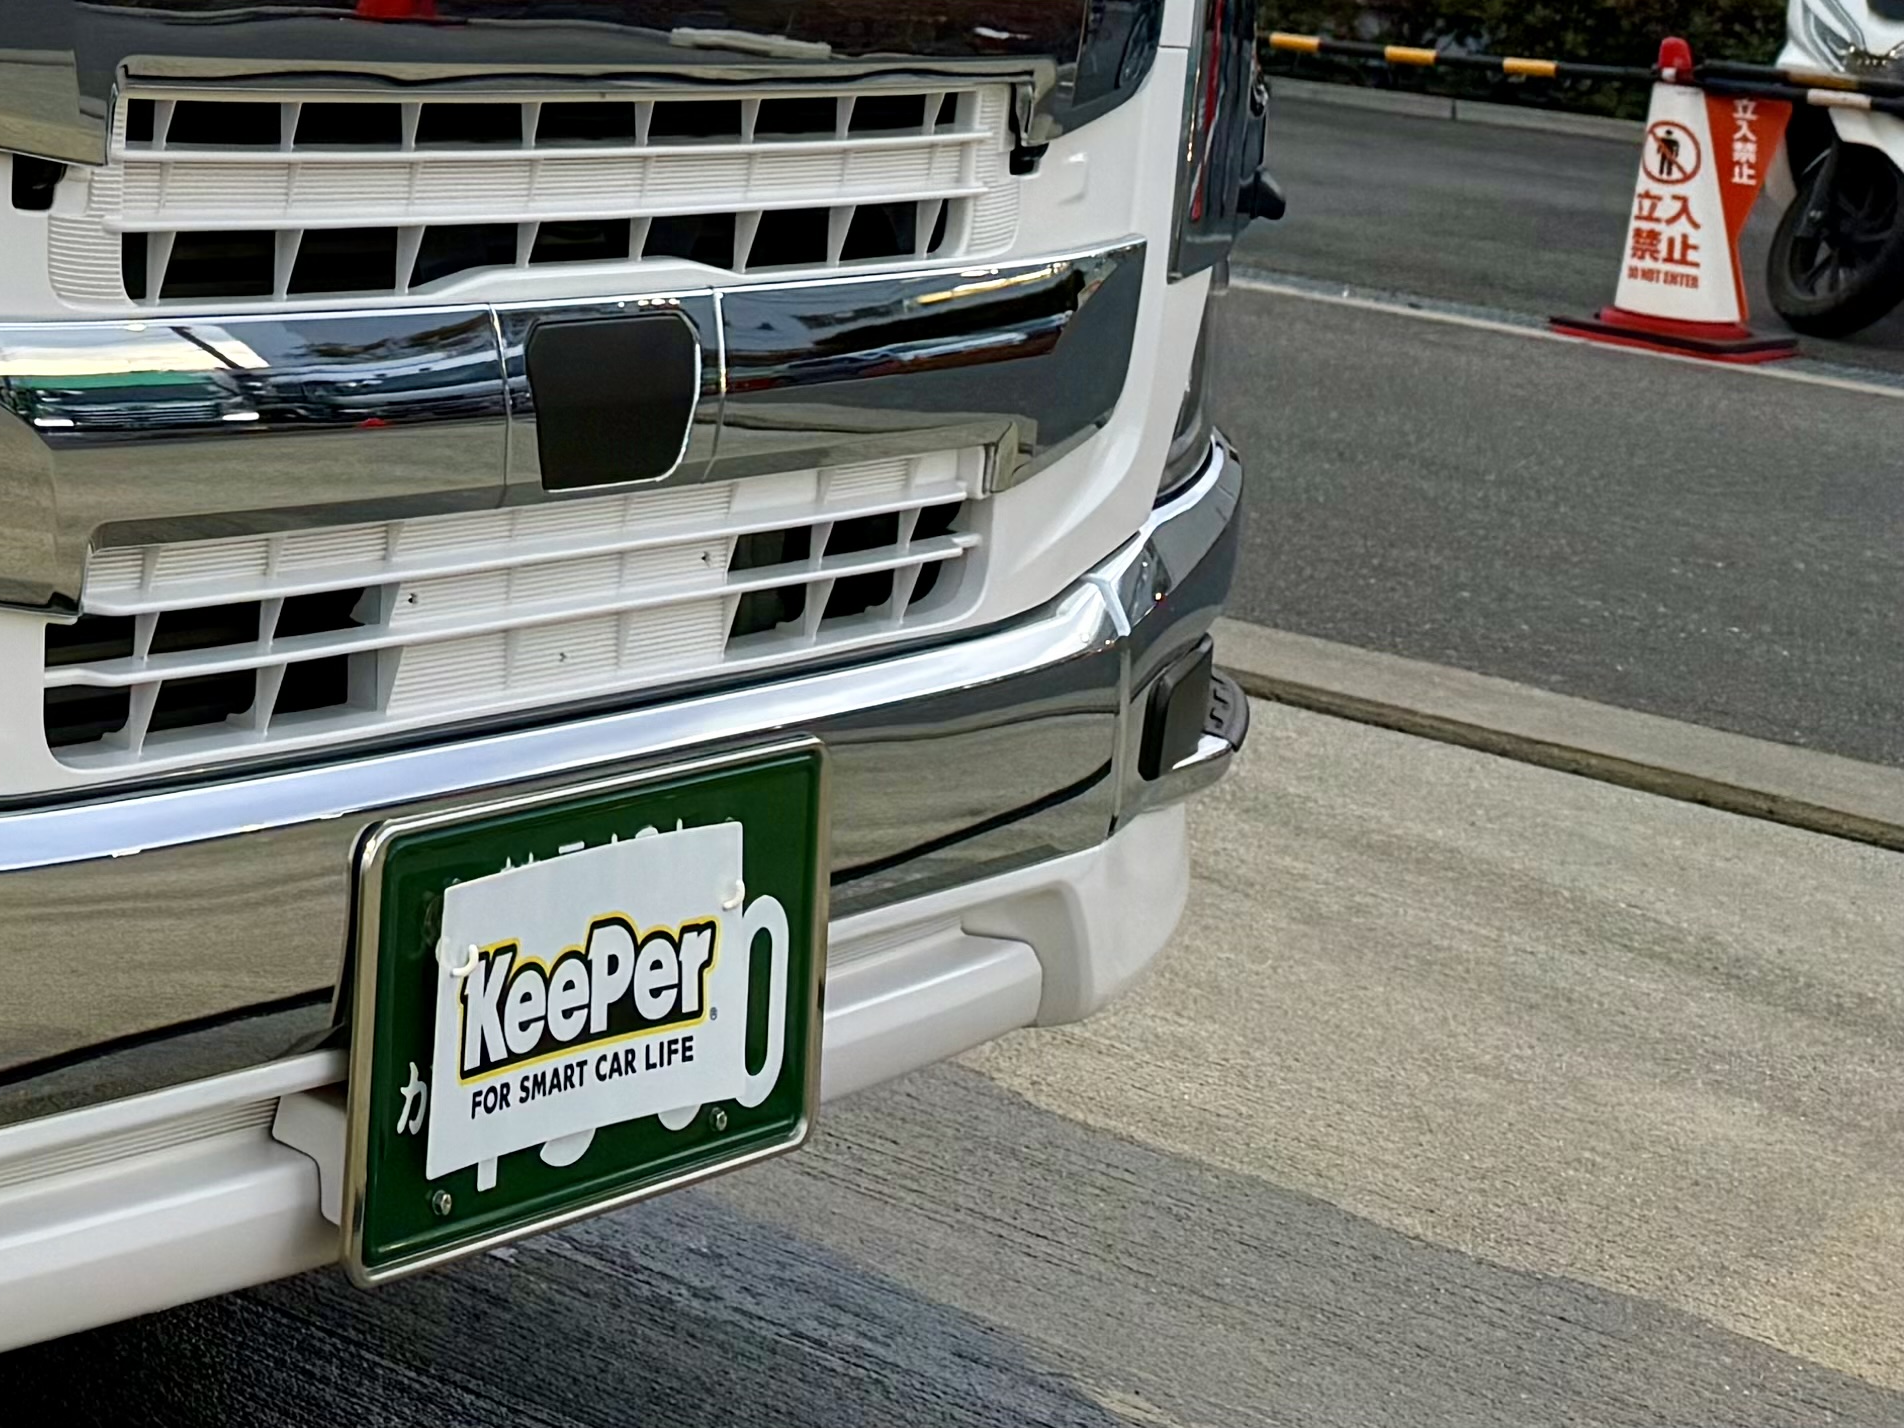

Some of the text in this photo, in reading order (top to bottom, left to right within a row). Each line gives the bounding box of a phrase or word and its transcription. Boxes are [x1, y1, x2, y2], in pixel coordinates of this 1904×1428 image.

[1732, 98, 1758, 185] 立入禁止
[1630, 226, 1702, 269] 禁止
[1633, 189, 1702, 232] 立入
[460, 920, 716, 1076] KeePer
[470, 1034, 696, 1121] FOR SMART CAR LIFE
